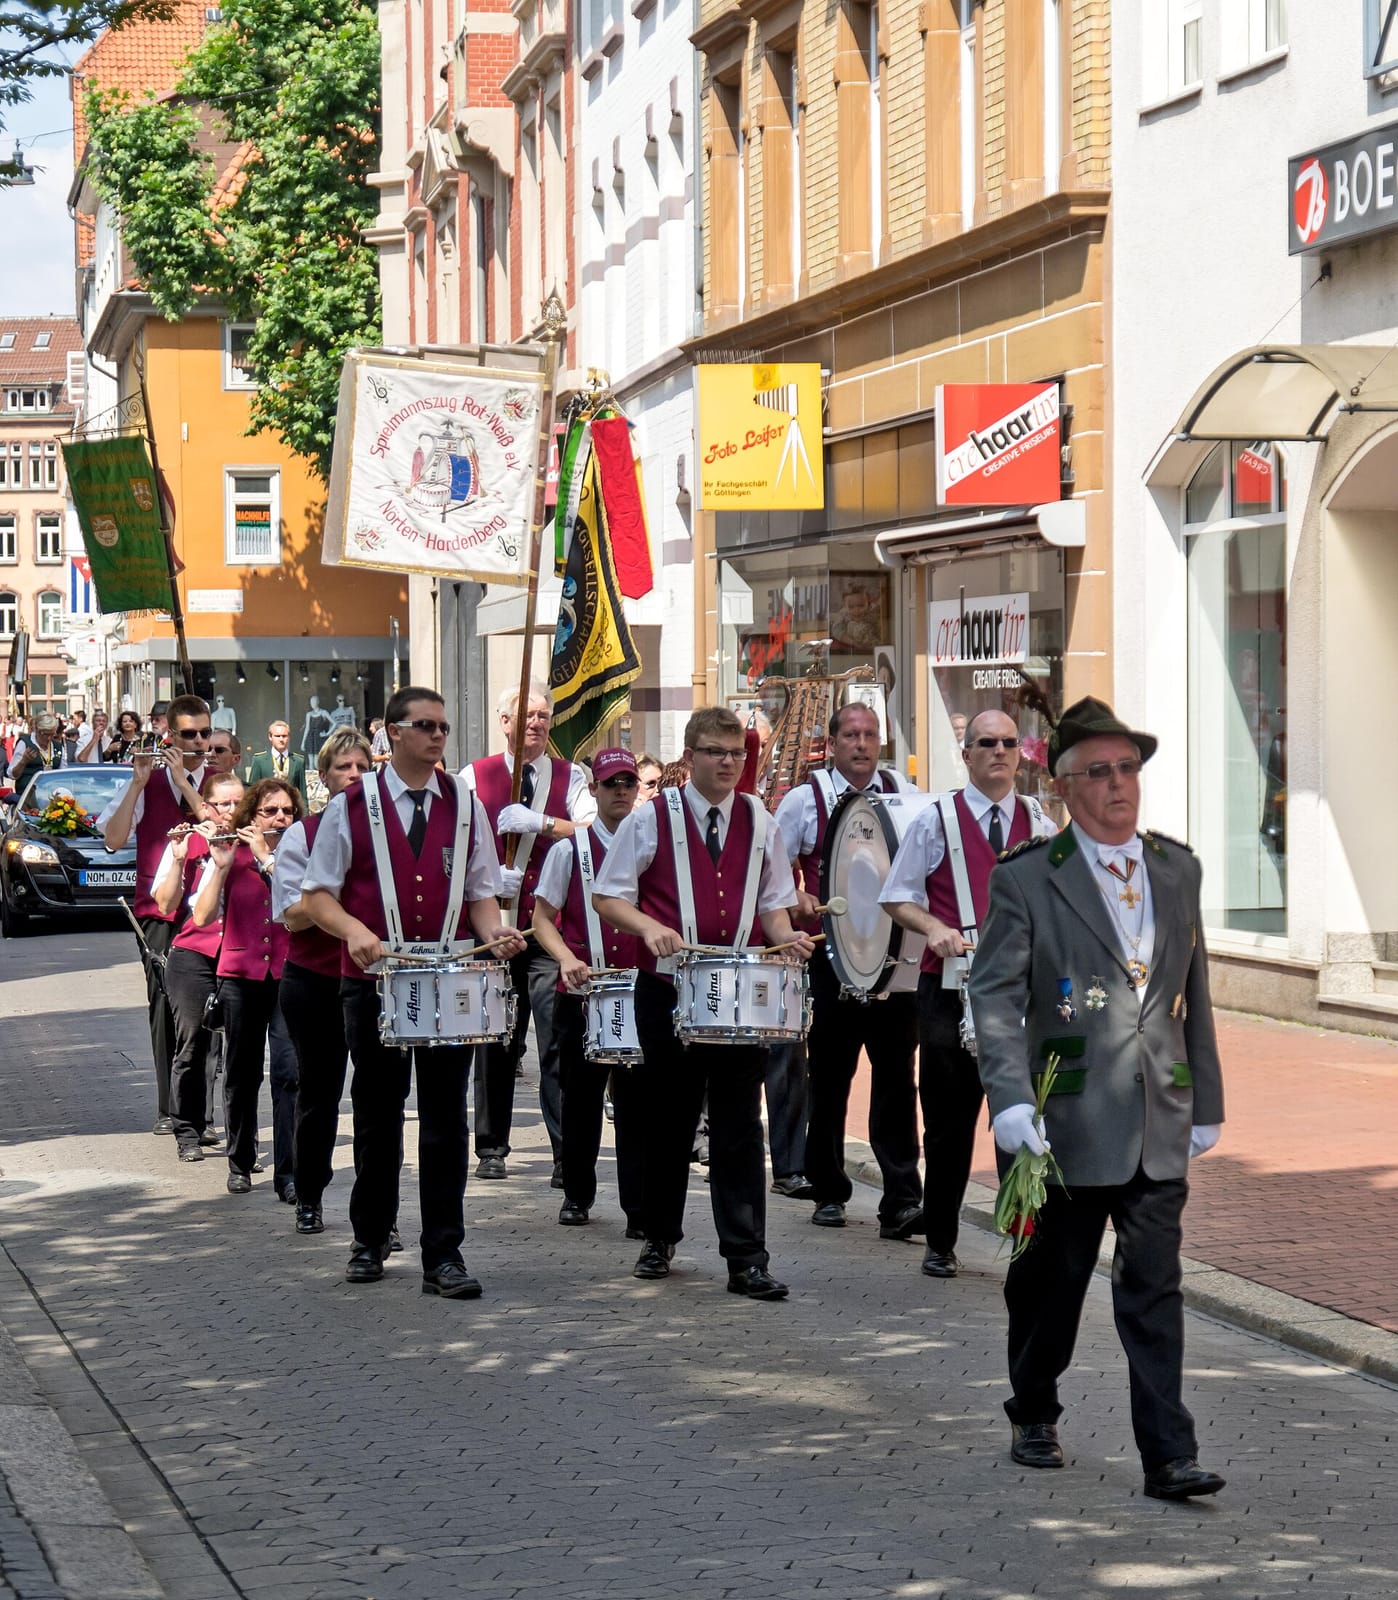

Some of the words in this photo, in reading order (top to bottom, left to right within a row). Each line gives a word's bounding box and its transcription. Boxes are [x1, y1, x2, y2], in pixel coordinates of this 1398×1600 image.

[1333, 142, 1398, 223] BOE
[370, 396, 457, 459] Spielmannszug
[461, 396, 514, 448] Rot-Weiß
[704, 441, 738, 464] Foto
[742, 424, 784, 450] Leifer
[982, 448, 1021, 477] CREATIVE
[1021, 425, 1057, 453] FRISEURE
[714, 489, 752, 497] Göttingen
[379, 499, 507, 551] Nörten-Hardenberg
[973, 668, 1002, 690] CREATIVE
[87, 872, 105, 883] NOM
[112, 872, 123, 883] OZ
[406, 981, 420, 1027] Lefima
[707, 971, 720, 1018] Lefima
[611, 1000, 624, 1041] Lefima
